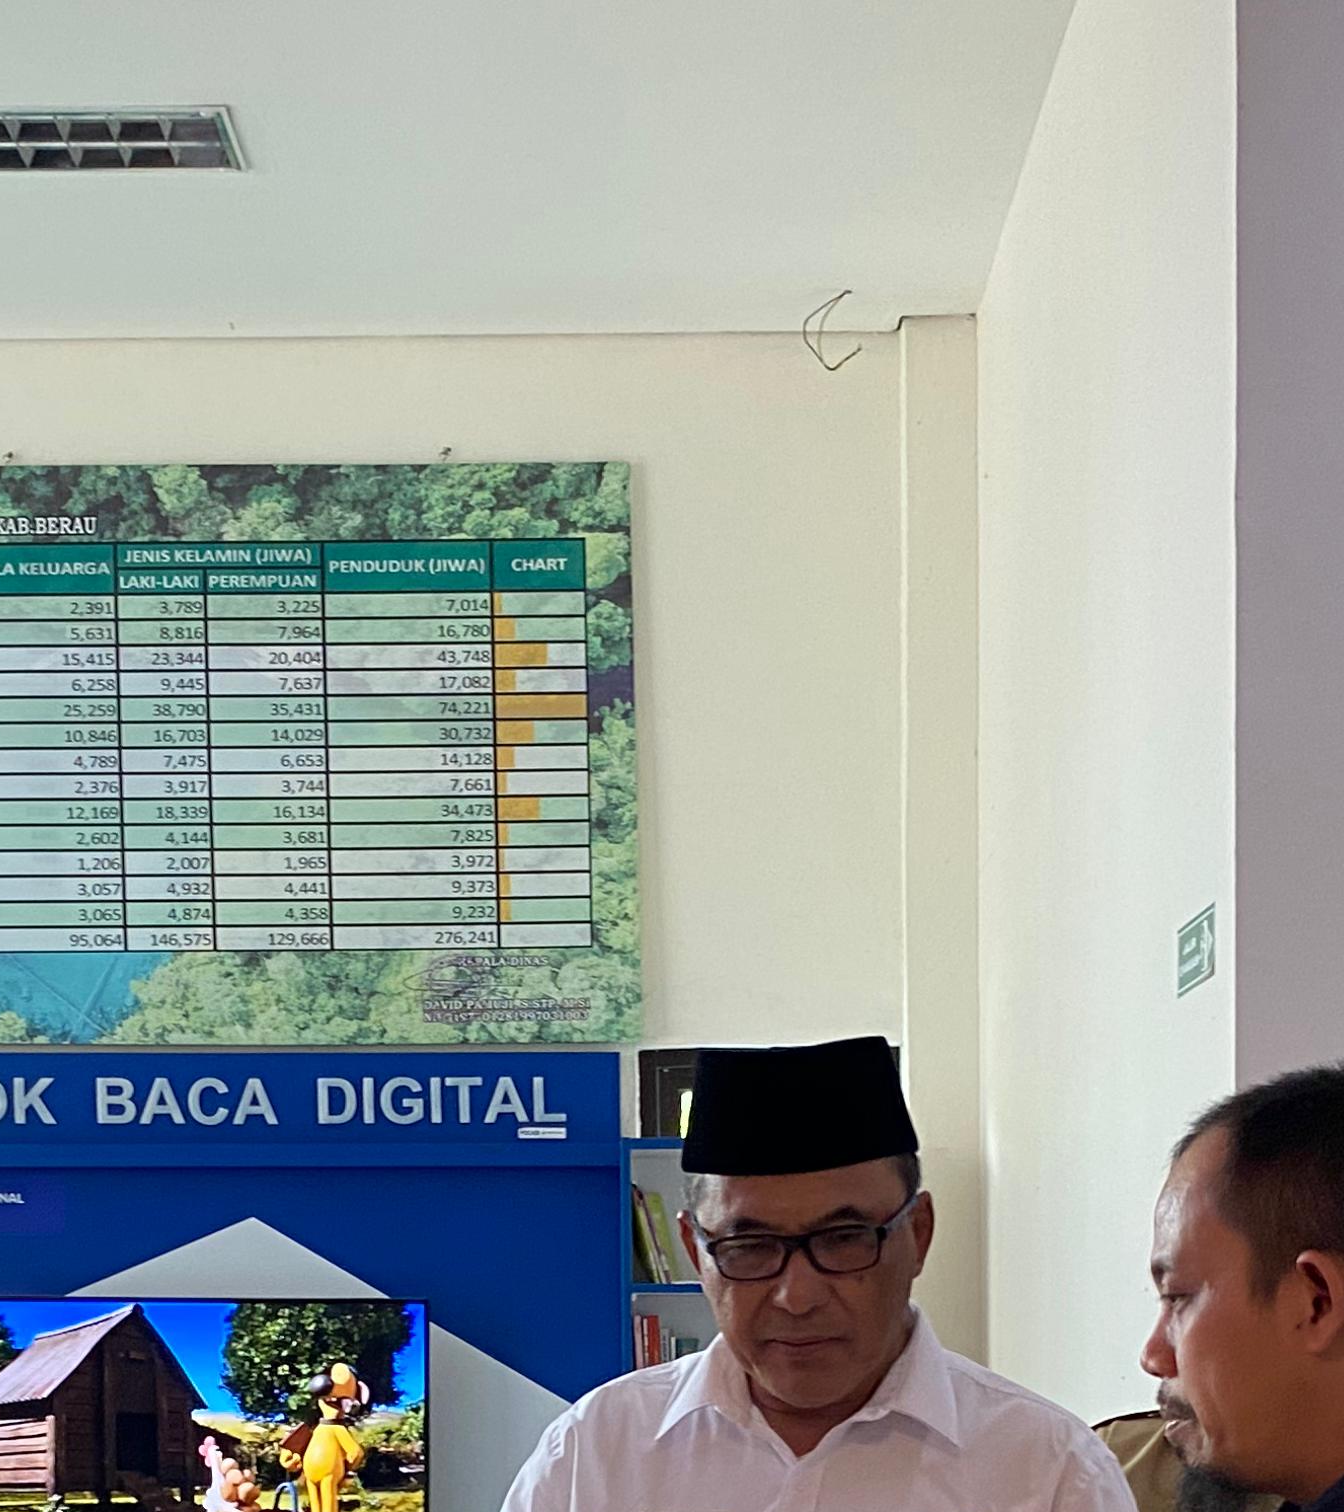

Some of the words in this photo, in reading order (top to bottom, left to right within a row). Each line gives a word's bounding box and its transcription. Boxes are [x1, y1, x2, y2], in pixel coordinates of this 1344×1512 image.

[124, 550, 171, 564] JENIS
[174, 549, 251, 562] KELAMIN
[255, 548, 313, 564] (JIWA)
[511, 558, 568, 571] CHART
[19, 561, 111, 576] KELUARGA
[328, 559, 425, 574] PENDUDUK
[429, 558, 485, 575] (JIWA)
[119, 575, 200, 589] LAKI-LAKI
[208, 575, 317, 589] PEREMPUAN
[69, 599, 113, 617] 2,391
[158, 601, 203, 616] 3,789
[276, 600, 321, 614] 3,225
[445, 598, 489, 614] 7,014
[70, 625, 114, 642] 5,631
[159, 627, 206, 642] 8,816
[276, 625, 321, 640] 7,964
[437, 624, 490, 640] 16,780
[62, 651, 115, 668] 15,415
[151, 653, 204, 667] 23,344
[269, 651, 322, 666] 20,404
[438, 650, 491, 665] 43,748
[71, 677, 118, 693] 6,258
[160, 678, 205, 693] 9,445
[279, 677, 325, 691] 7,637
[439, 675, 494, 691] 17,082
[63, 702, 116, 719] 25,259
[152, 704, 208, 718] 38,790
[270, 702, 323, 717] 35,431
[438, 701, 491, 716] 74,221
[64, 728, 117, 744] 10,846
[154, 729, 206, 744] 16,703
[271, 728, 327, 742] 14,029
[439, 727, 494, 742] 30,732
[74, 754, 118, 770] 4,789
[163, 755, 210, 769] 7,475
[280, 754, 325, 769] 6,653
[441, 752, 495, 767] 14,128
[74, 779, 121, 795] 2,376
[164, 780, 207, 794] 3,917
[281, 779, 328, 794] 3,744
[449, 778, 493, 793] 7,661
[66, 805, 119, 820] 12,169
[156, 806, 209, 820] 18,339
[273, 805, 326, 819] 16,134
[441, 803, 494, 818] 34,473
[76, 831, 120, 846] 2,602
[165, 831, 209, 846] 4,144
[283, 831, 326, 845] 3,681
[450, 829, 494, 844] 7,825
[77, 857, 123, 871] 1,206
[166, 856, 212, 871] 2,007
[284, 856, 330, 871] 1,965
[451, 854, 494, 870] 3,972
[77, 882, 124, 897] 3,057
[166, 882, 210, 897] 4,932
[284, 882, 328, 897] 4,441
[451, 880, 497, 895] 9,373
[78, 908, 122, 922] 3,065
[167, 907, 211, 922] 4,874
[284, 907, 329, 921] 4,358
[452, 905, 496, 920] 9,232
[69, 934, 123, 948] 95,064
[150, 933, 212, 947] 146,575
[268, 932, 331, 947] 129,666
[434, 930, 496, 945] 276,241
[95, 1077, 279, 1125] BACA
[316, 1076, 568, 1124] DIGITAL
